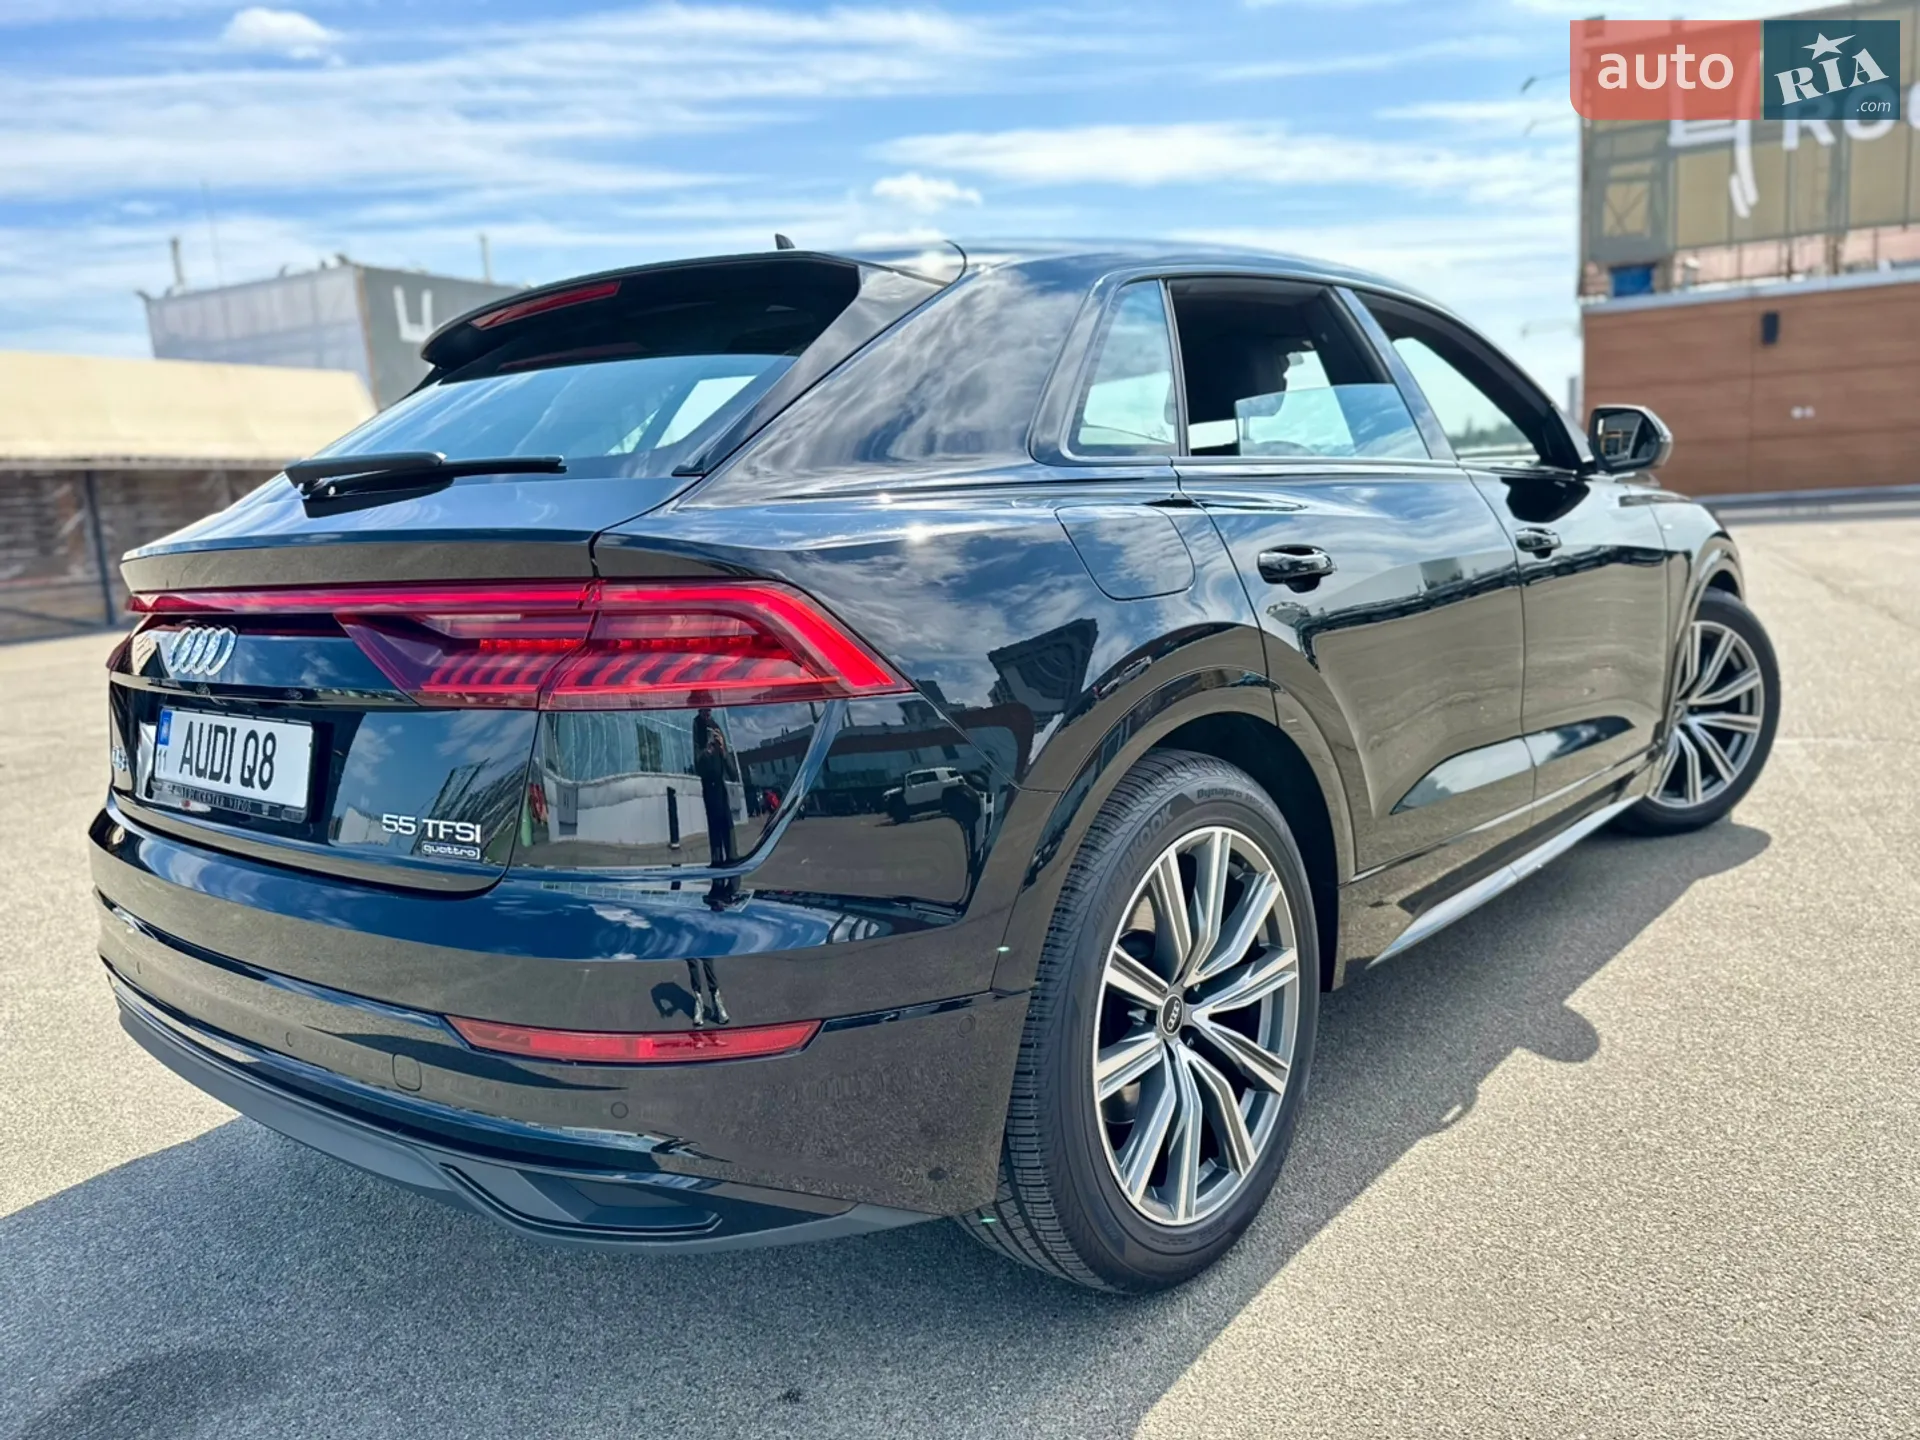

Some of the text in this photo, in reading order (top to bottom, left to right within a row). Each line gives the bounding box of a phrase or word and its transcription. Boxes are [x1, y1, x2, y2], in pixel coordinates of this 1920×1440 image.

[179, 720, 277, 791] AUDI Q8
[382, 813, 481, 843] 55 TFSI
[423, 845, 476, 857] quattro
